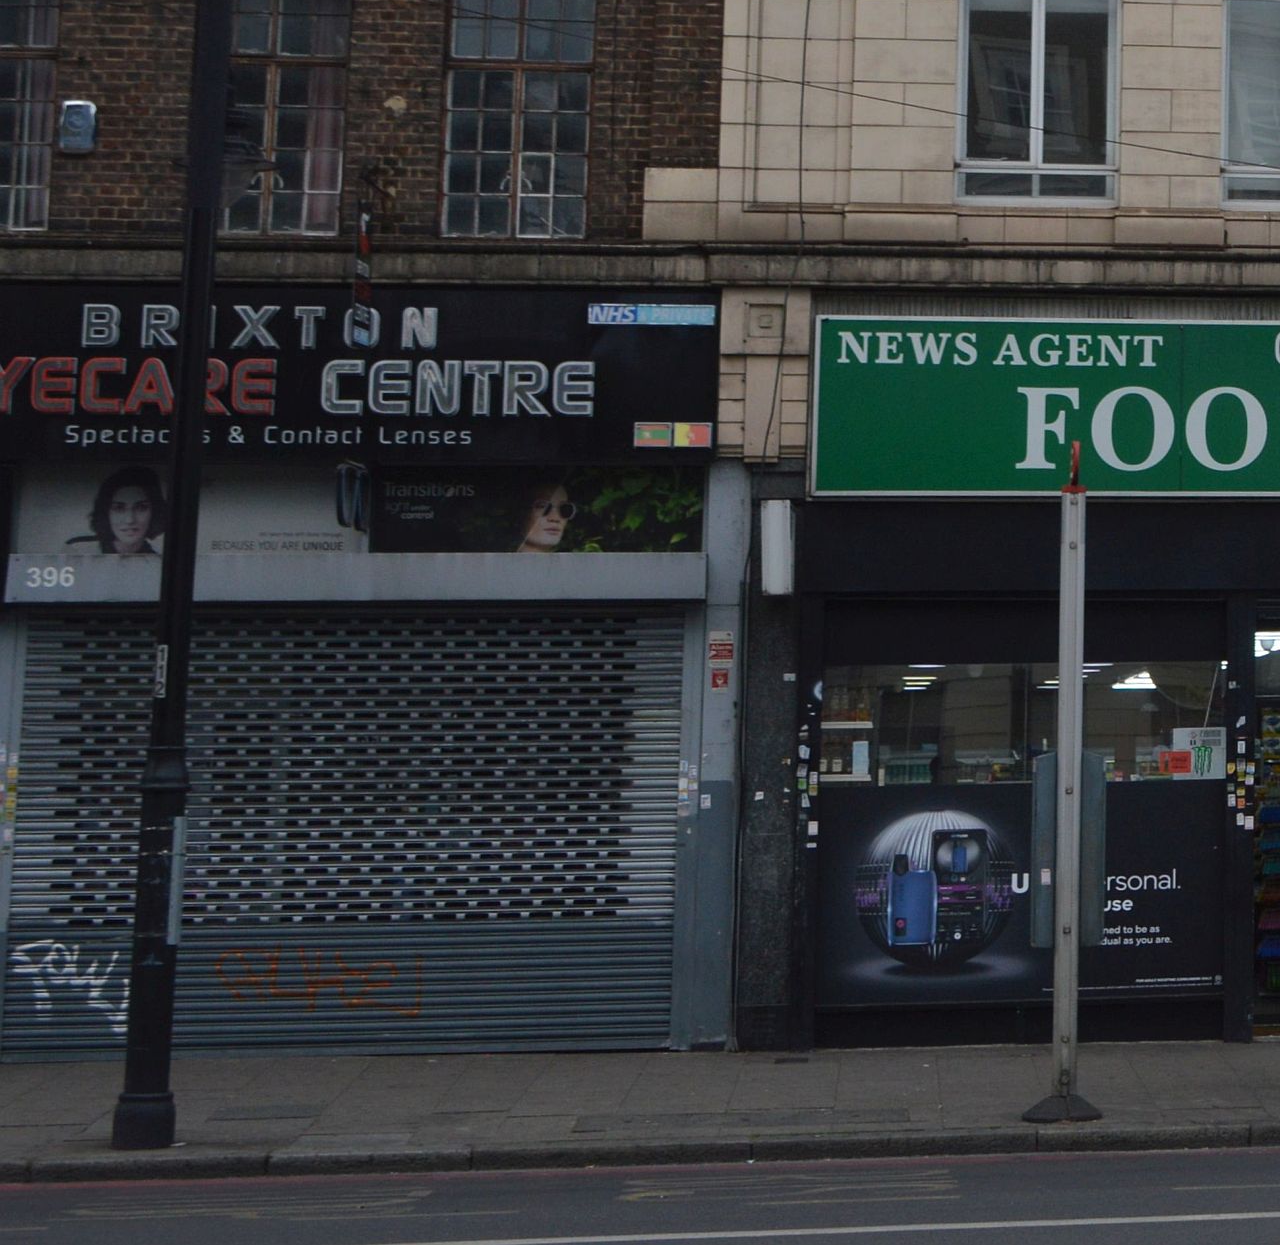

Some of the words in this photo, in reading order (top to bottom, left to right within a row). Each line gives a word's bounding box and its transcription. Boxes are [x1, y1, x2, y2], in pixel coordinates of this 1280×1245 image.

[592, 305, 636, 323] NHS
[81, 303, 438, 349] BRXTON
[836, 331, 978, 366] NEWS
[993, 333, 1164, 368] AGENT
[320, 359, 595, 417] CENTRE
[65, 425, 211, 447] Spectacs
[228, 426, 245, 444] &
[264, 425, 363, 445] Contact
[379, 426, 472, 444] Lenses
[384, 483, 475, 498] Transitions
[211, 541, 256, 551] BECAUSE
[259, 541, 278, 551] YOU
[281, 541, 301, 551] ARE
[302, 541, 344, 551] UNIQUE
[26, 566, 76, 588] 396
[1104, 868, 1182, 892] rsonal.
[1123, 925, 1134, 935] to
[1135, 925, 1148, 935] be
[1150, 926, 1161, 934] as
[1123, 937, 1134, 945] as
[1135, 937, 1154, 948] you
